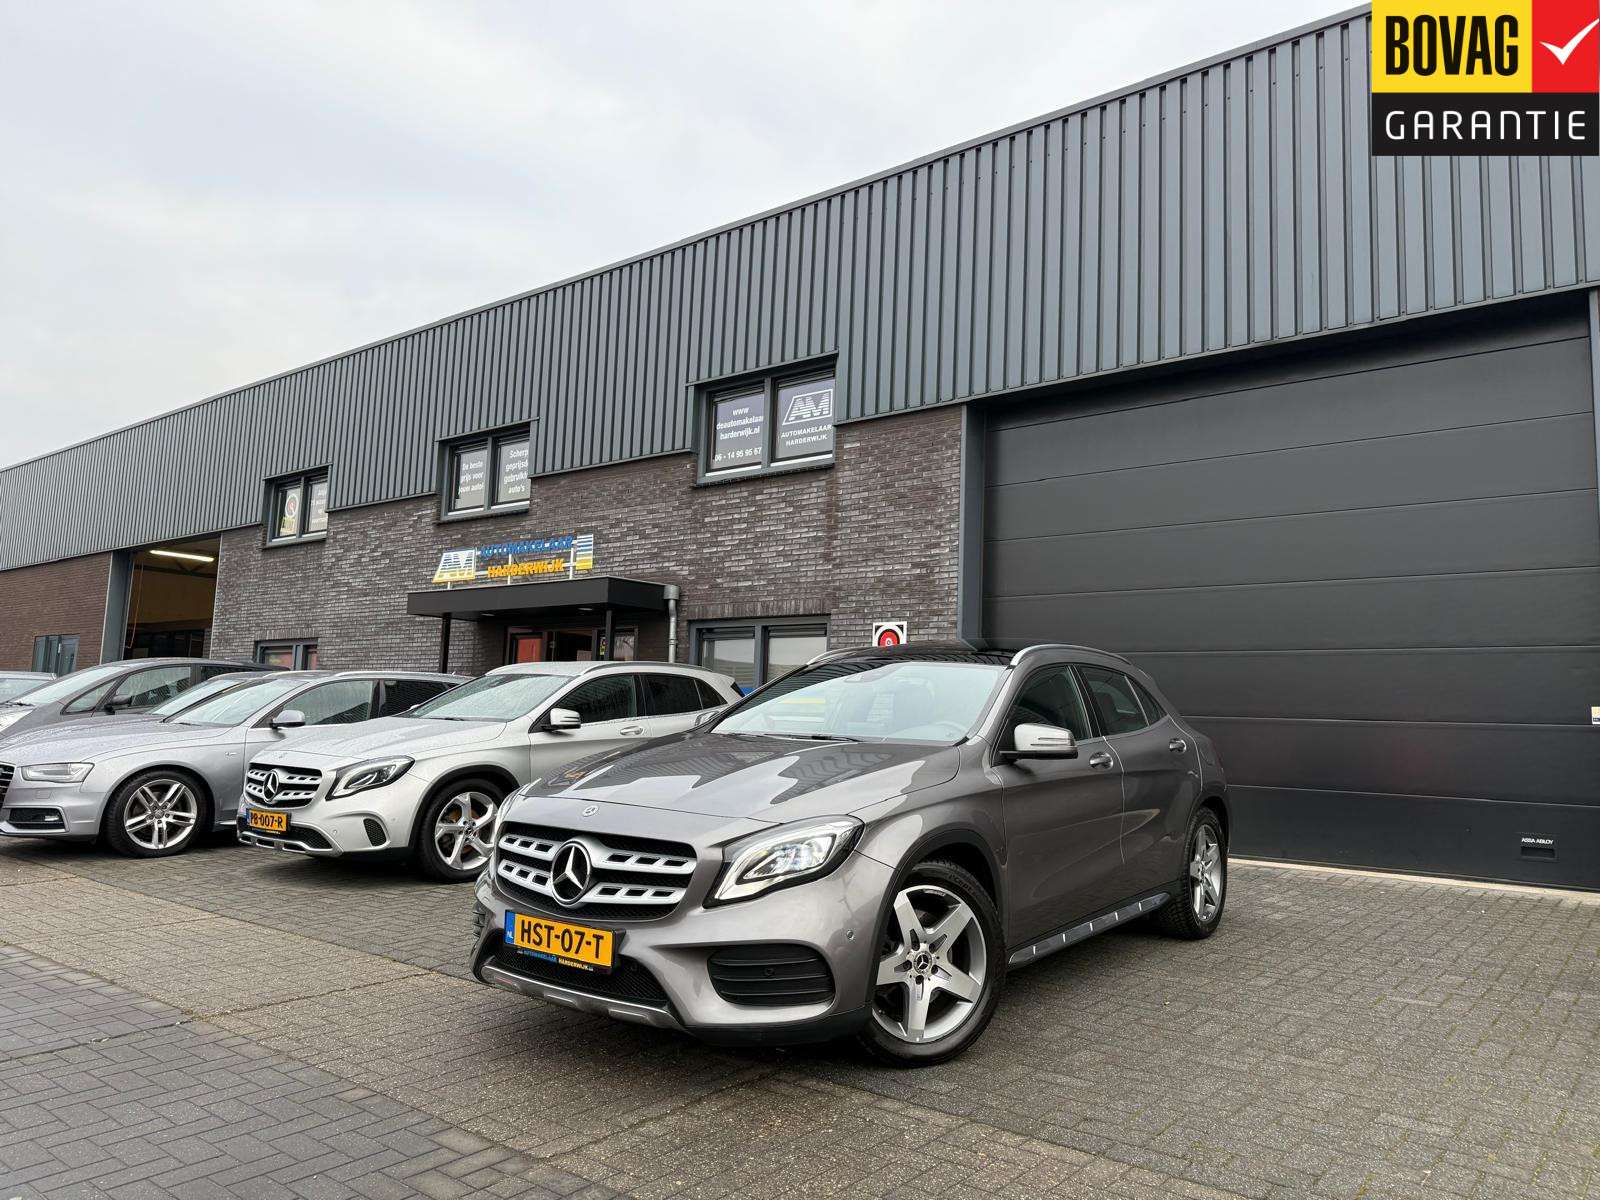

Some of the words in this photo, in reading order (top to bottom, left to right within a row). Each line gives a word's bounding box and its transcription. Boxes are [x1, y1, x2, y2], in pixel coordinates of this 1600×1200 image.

[720, 425, 760, 440] harderwijk.nl
[781, 424, 832, 438] AUTOMAKELAAR
[785, 433, 827, 446] HARDERWIJK
[520, 919, 604, 959] HST-07-T
